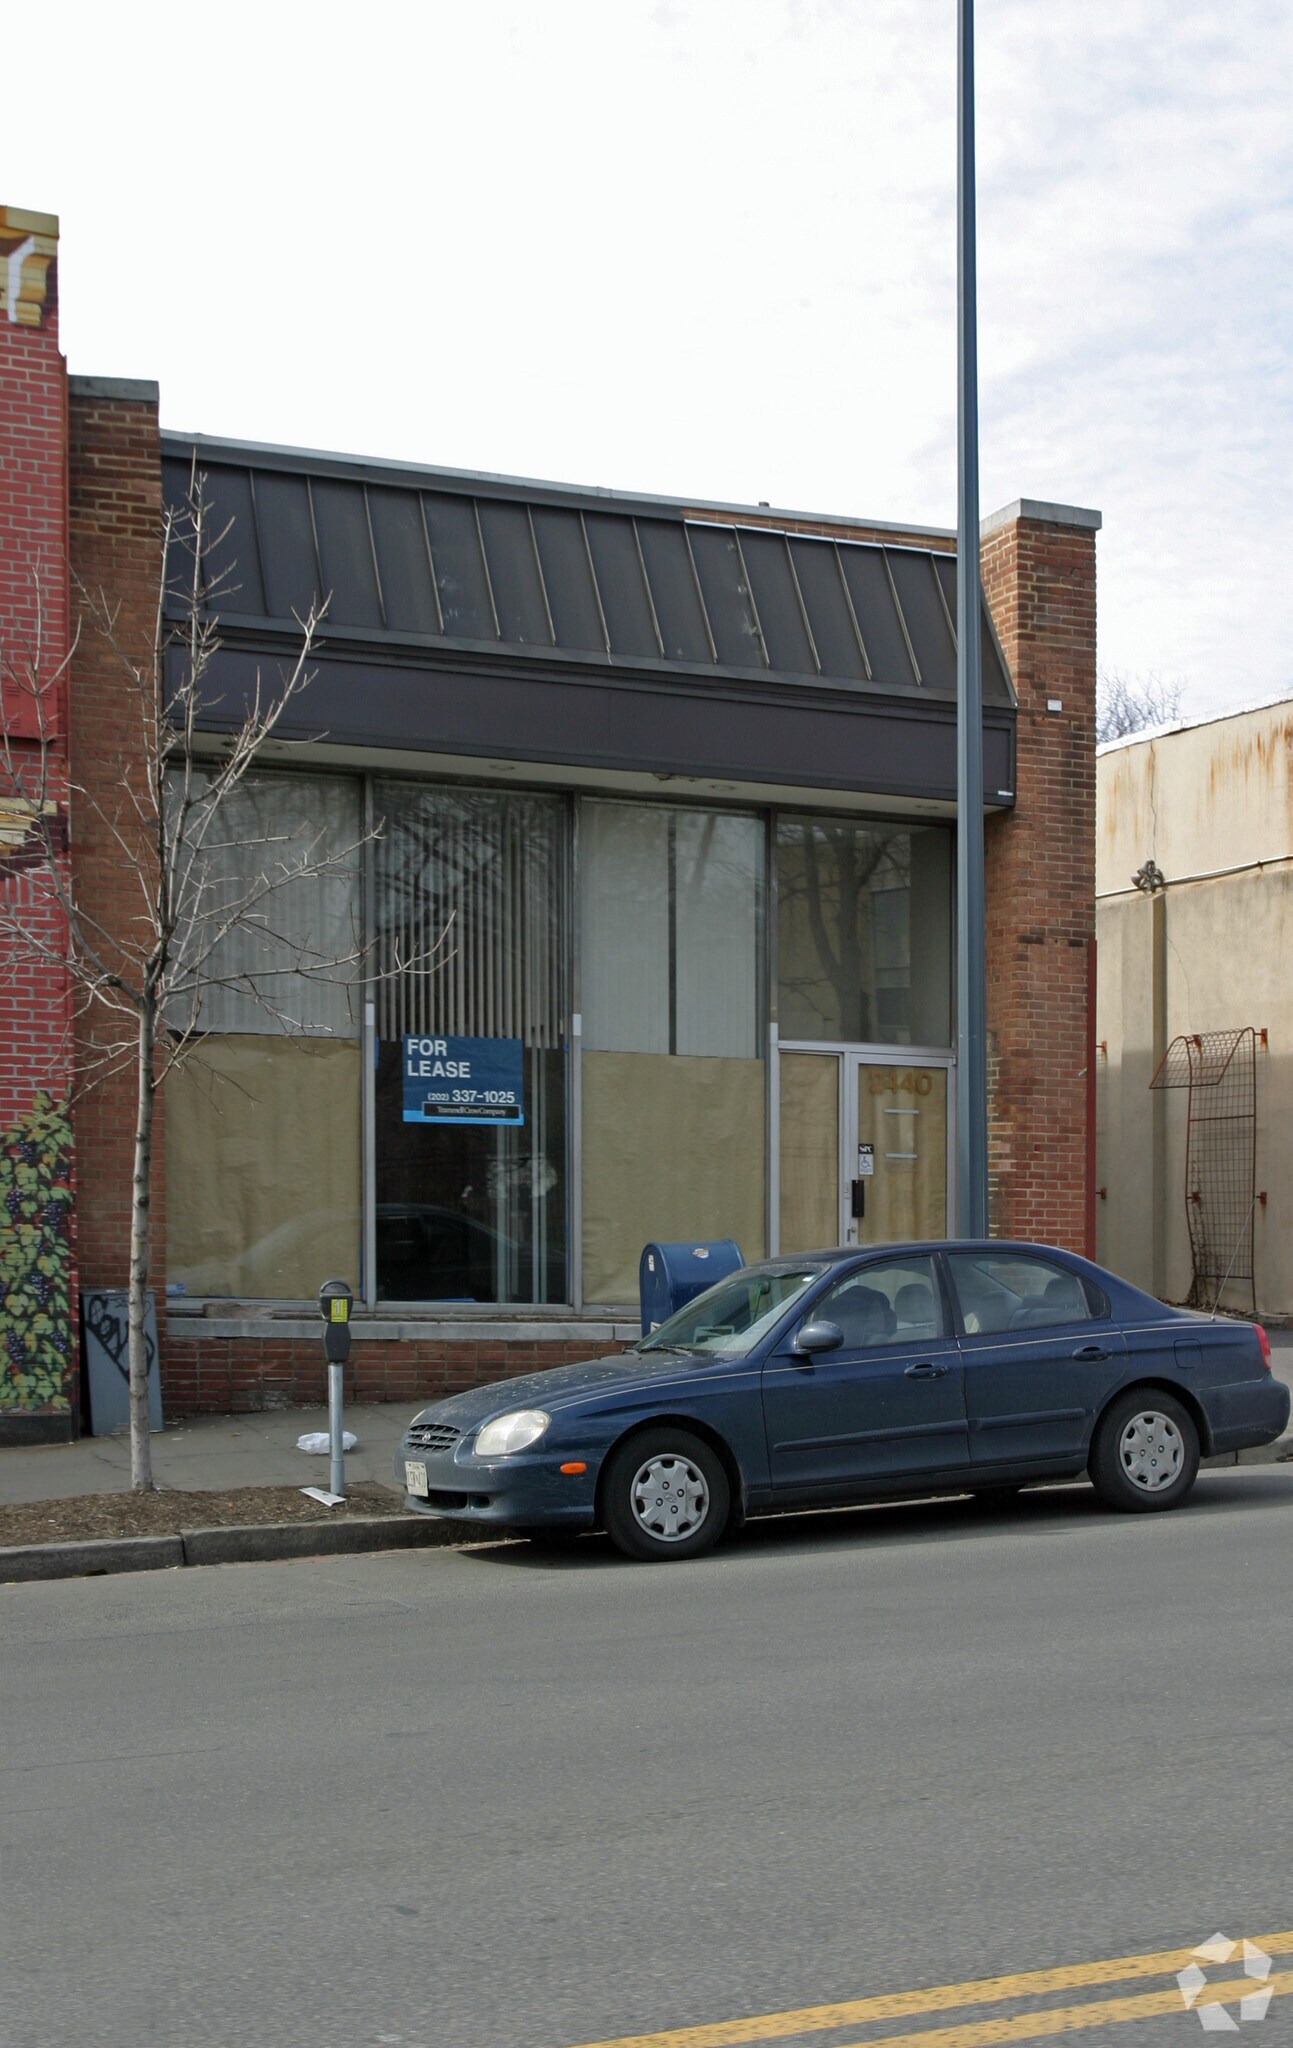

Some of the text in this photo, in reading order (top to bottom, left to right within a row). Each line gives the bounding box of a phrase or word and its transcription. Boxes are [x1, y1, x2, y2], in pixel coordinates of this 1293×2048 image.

[407, 1039, 447, 1056] FOR
[407, 1060, 471, 1078] LEASE
[428, 1090, 515, 1103] (202) 337-1025
